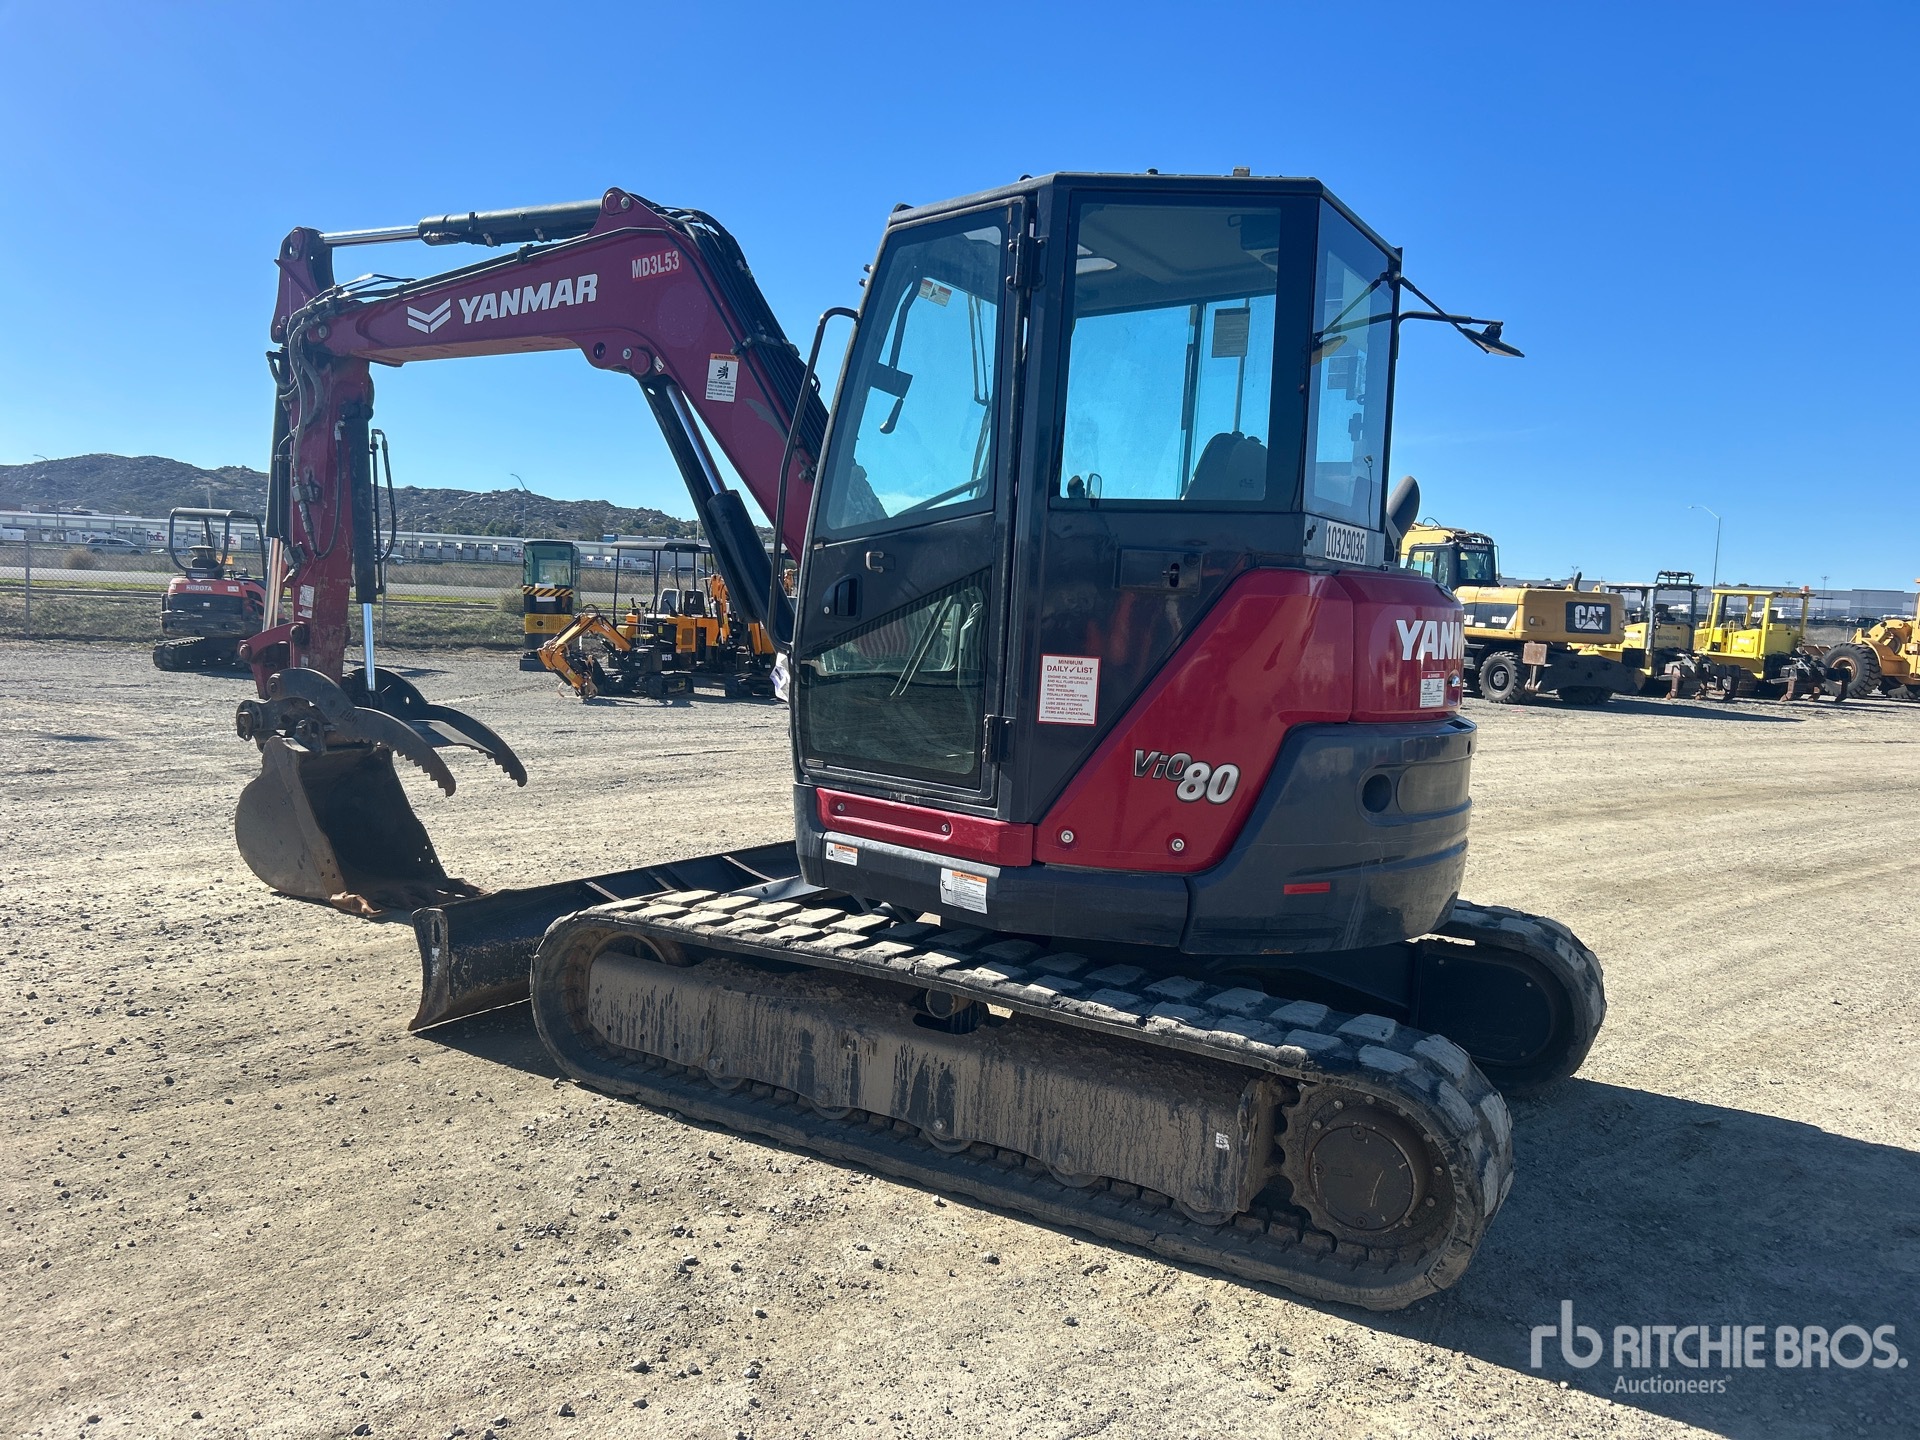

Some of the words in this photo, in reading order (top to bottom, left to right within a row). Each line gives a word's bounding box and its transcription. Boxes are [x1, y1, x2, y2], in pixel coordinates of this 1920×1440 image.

[631, 251, 680, 279] MD3L53
[458, 273, 598, 324] YANMAR
[146, 531, 165, 542] FedEx
[1326, 525, 1365, 562] 10329036
[186, 584, 213, 592] KUBOTA
[1574, 604, 1605, 630] CAT
[1046, 664, 1069, 673] DAILY
[1076, 666, 1093, 674] LIST
